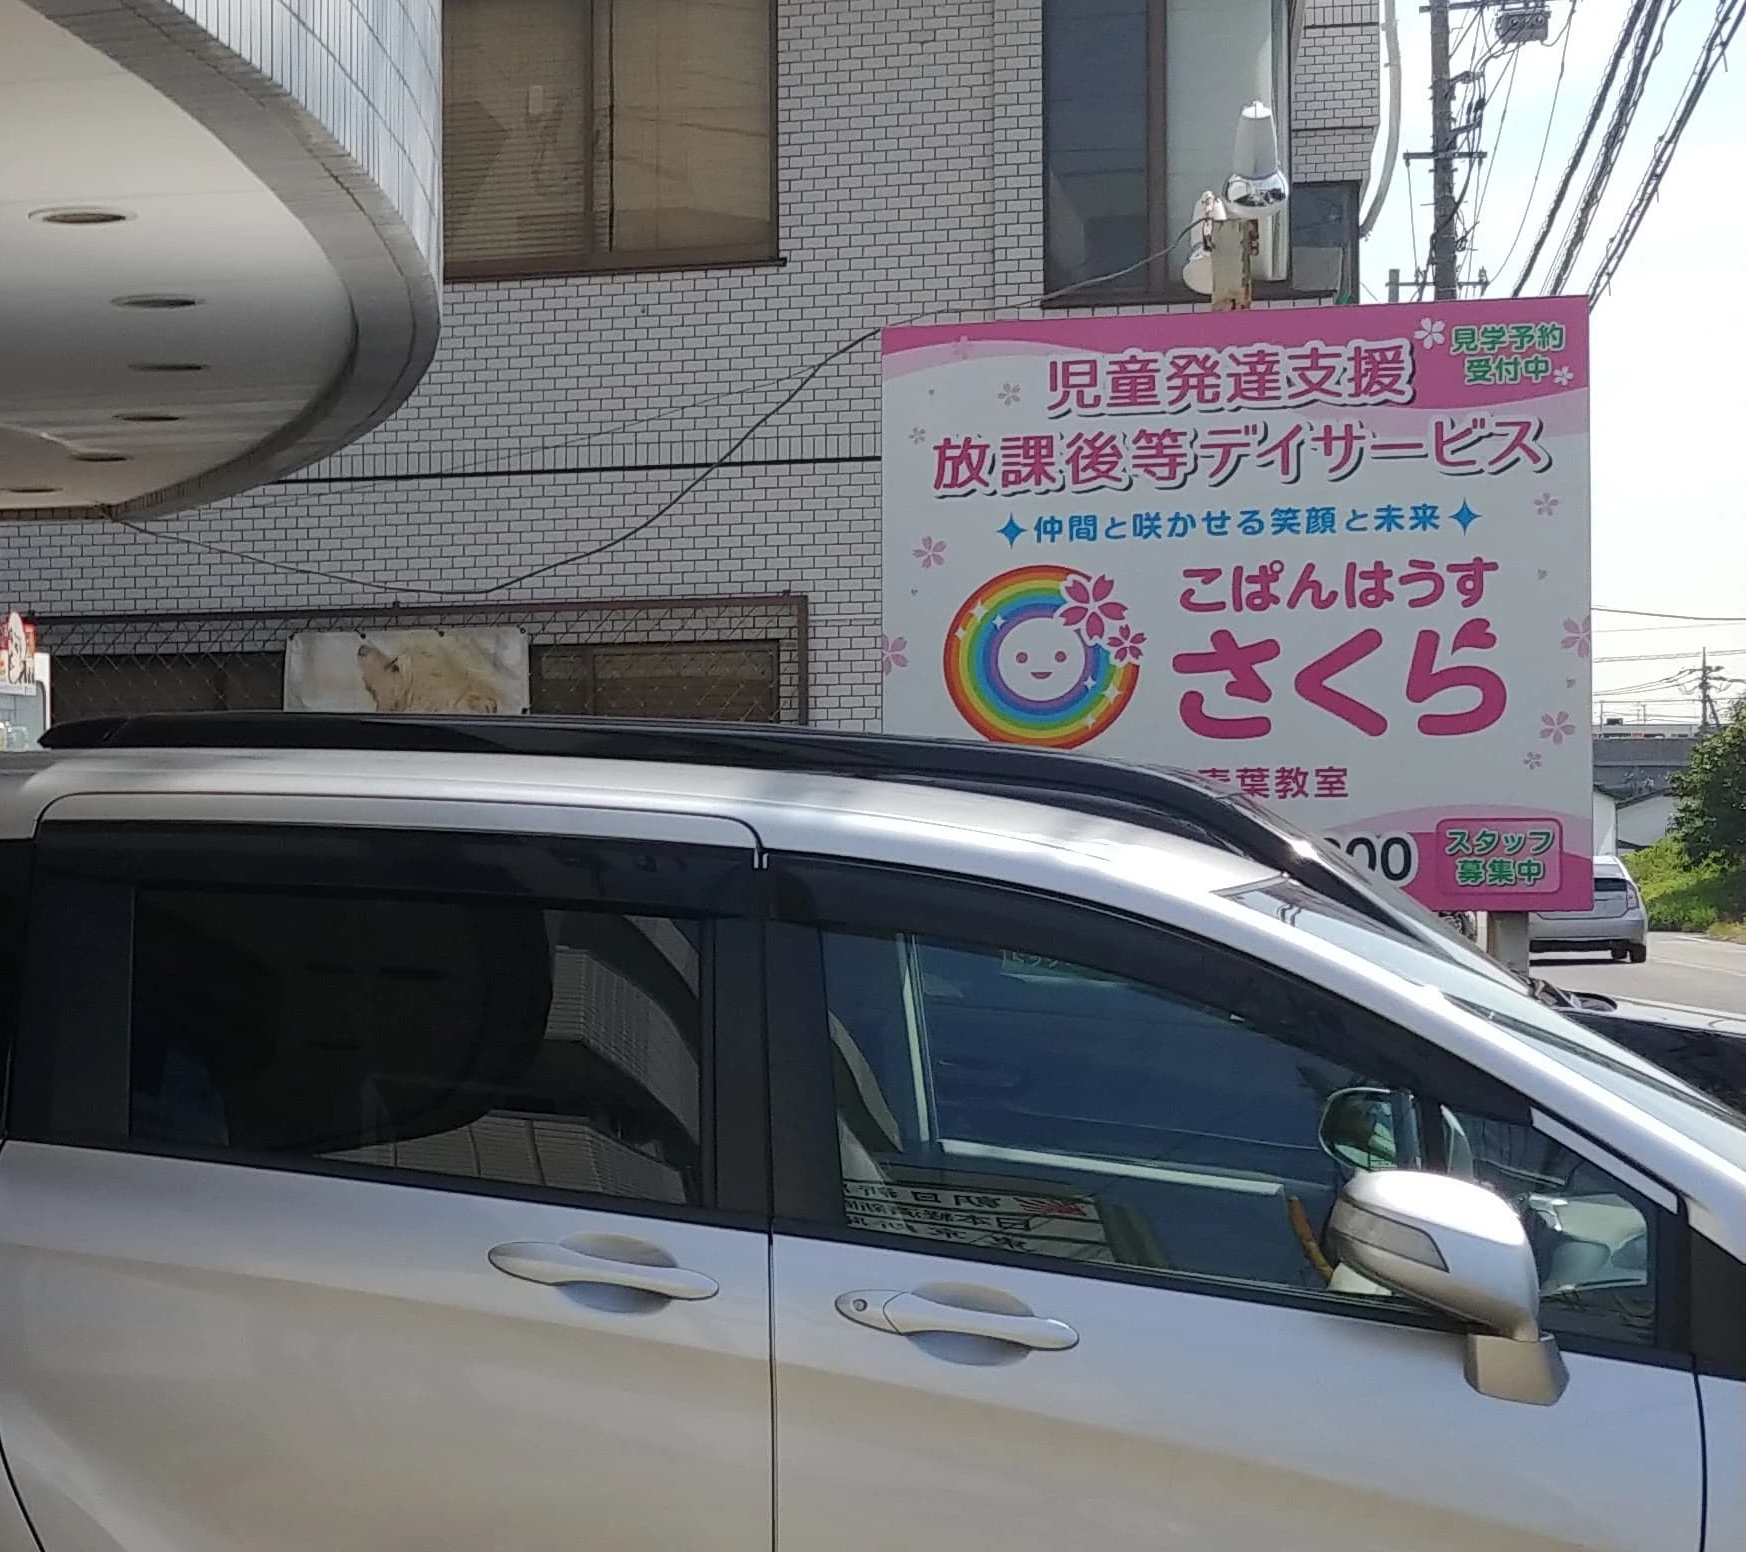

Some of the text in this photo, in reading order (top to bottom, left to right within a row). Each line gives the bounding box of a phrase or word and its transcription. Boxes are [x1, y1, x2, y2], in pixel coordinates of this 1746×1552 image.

[1449, 324, 1566, 353] 見学予約
[1047, 345, 1409, 415] 児童発達支援
[1464, 355, 1551, 385] 受付中
[932, 418, 1548, 493] 放課後等デイサービス
[1033, 503, 1441, 544] 仲間と咲かせる笑顔と未来
[1178, 557, 1500, 612] こぱんはうす
[1171, 617, 1508, 739] さくら
[1323, 836, 1412, 882] 00
[1446, 829, 1555, 854] スタッフ
[1457, 858, 1545, 886] 募集中
